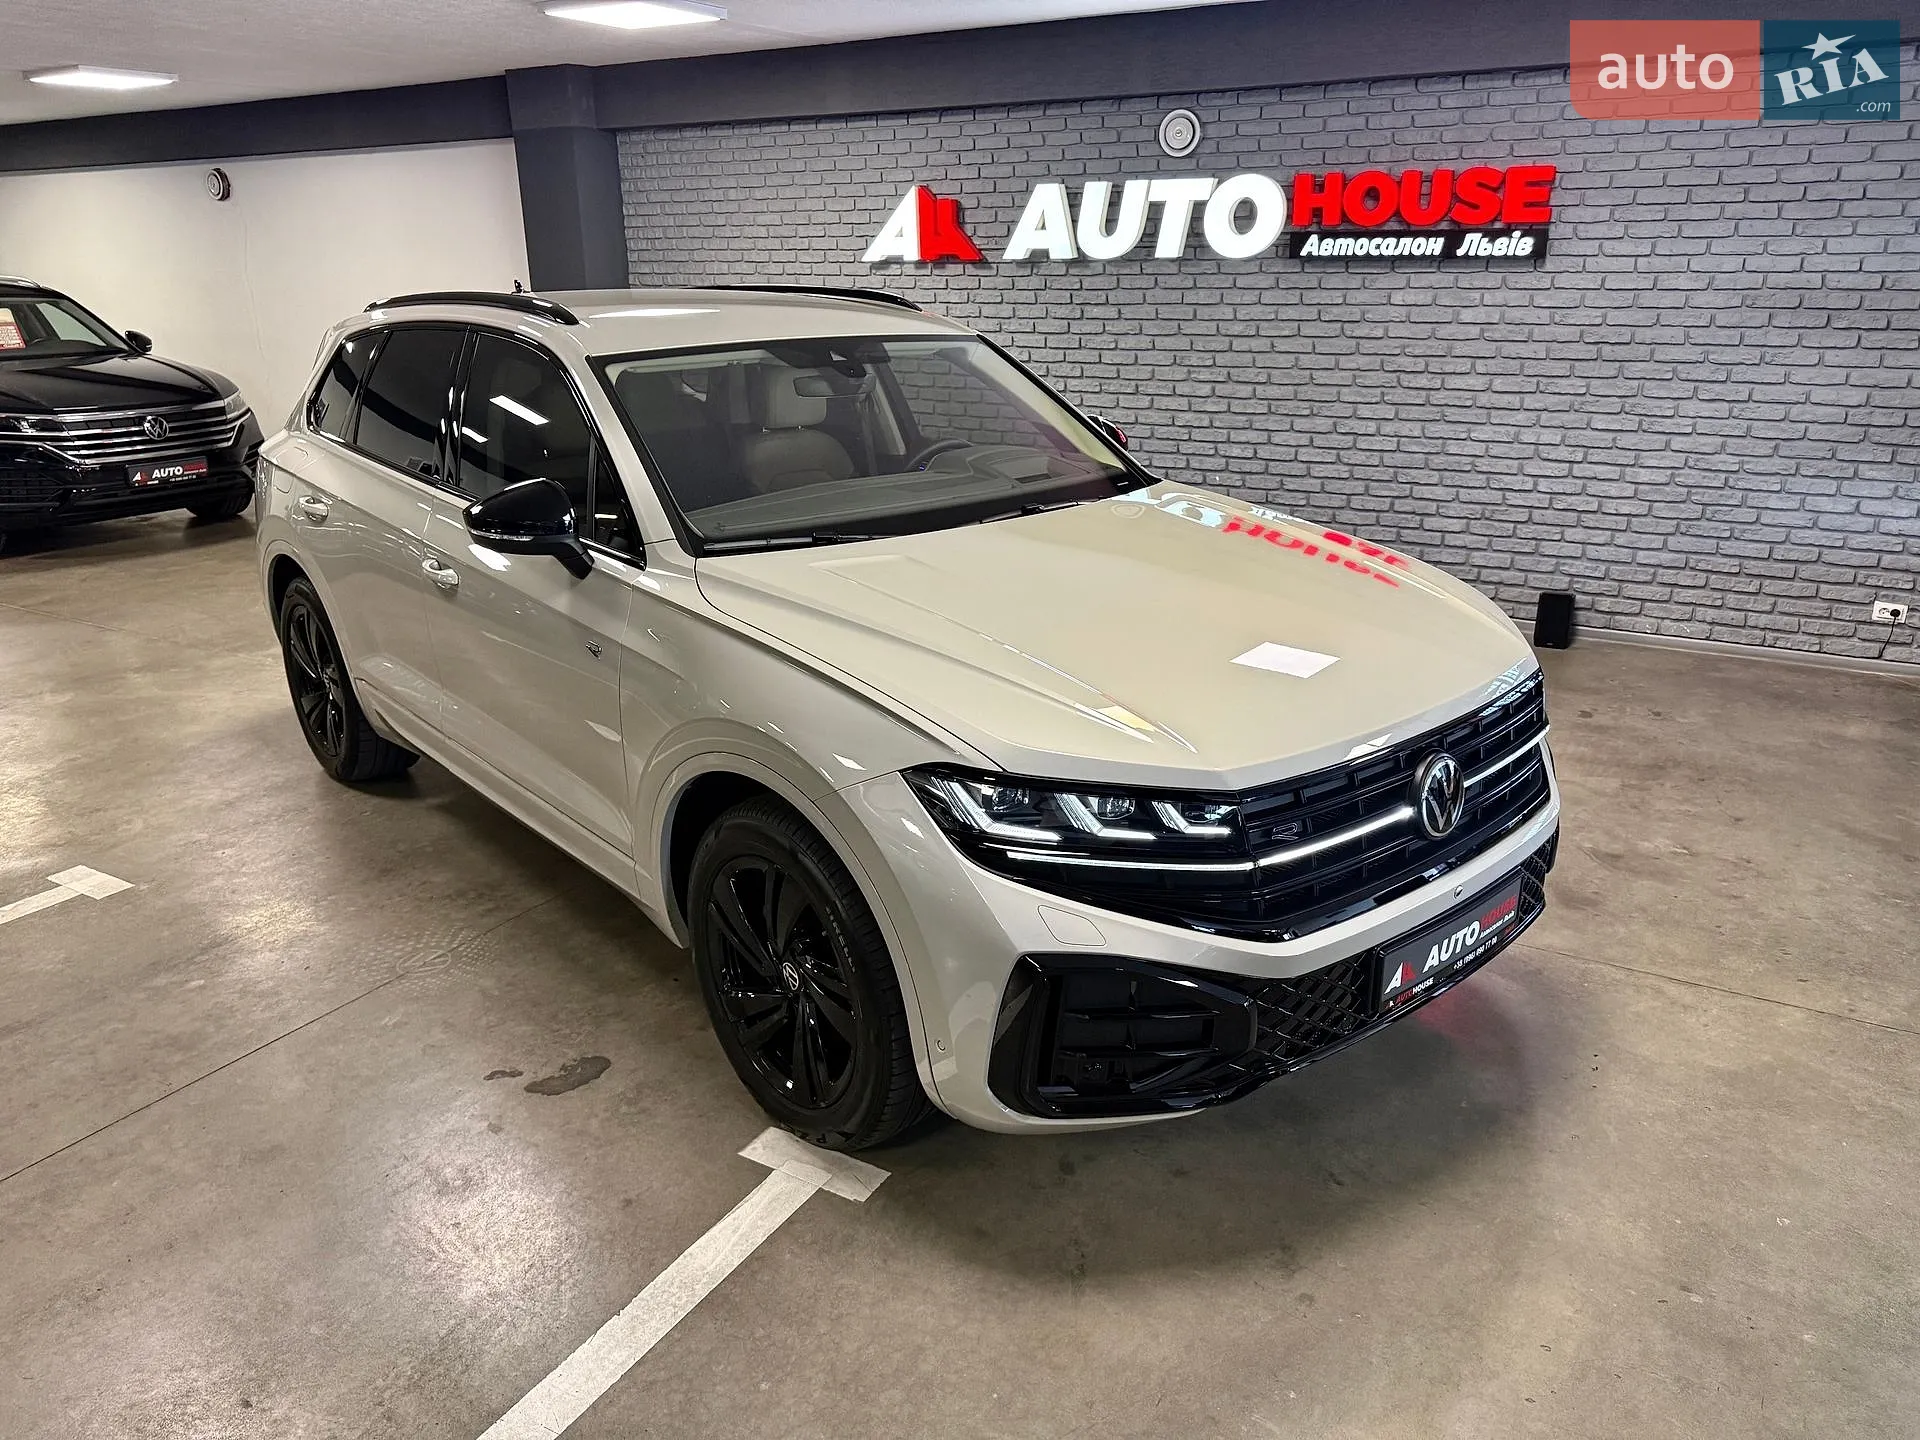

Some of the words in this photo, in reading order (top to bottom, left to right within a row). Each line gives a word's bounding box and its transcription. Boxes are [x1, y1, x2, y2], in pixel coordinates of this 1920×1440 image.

[1002, 173, 1288, 261] AUTO
[1293, 164, 1557, 228] HOUSE
[1300, 233, 1445, 257] Автосалон
[1456, 230, 1535, 257] Львів
[152, 466, 183, 479] AUTO
[1423, 920, 1481, 973] AUTO
